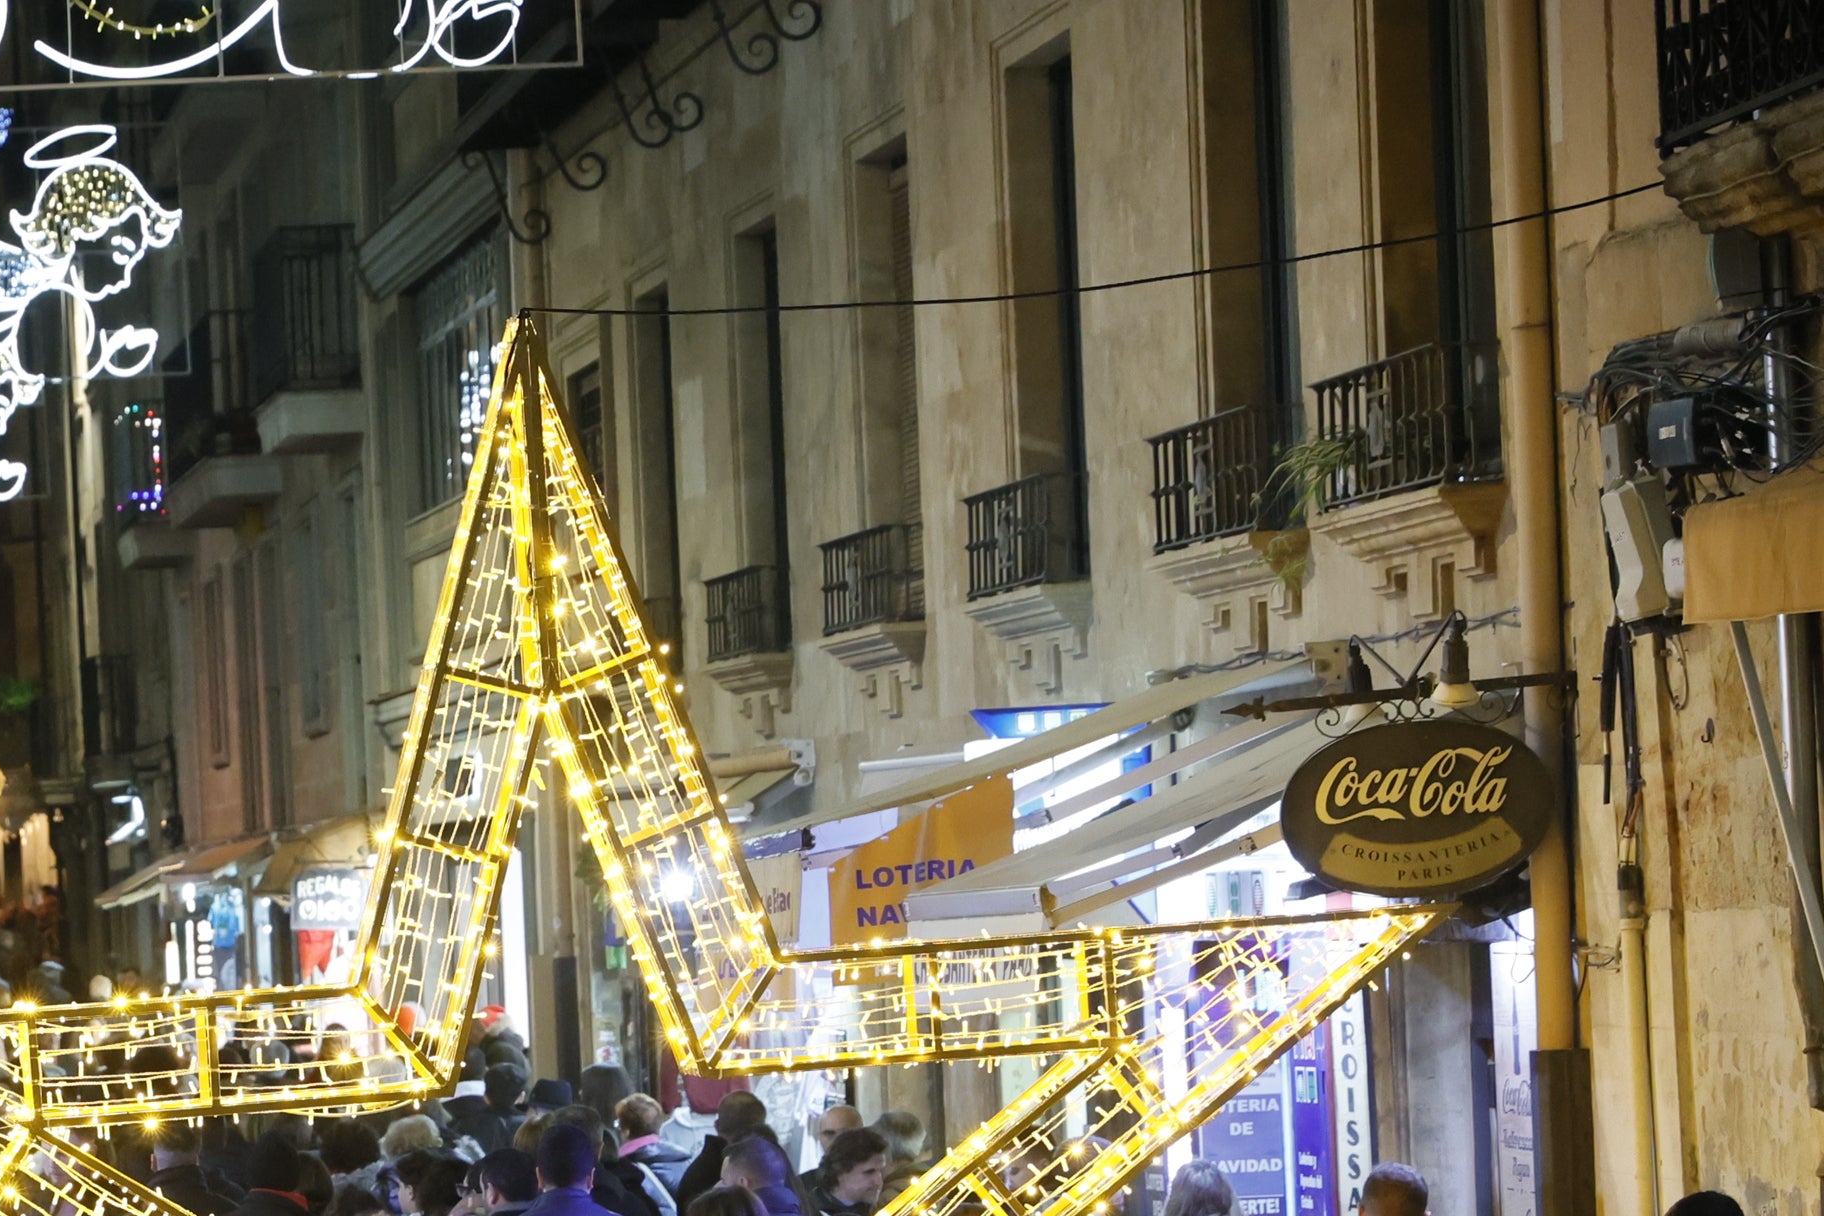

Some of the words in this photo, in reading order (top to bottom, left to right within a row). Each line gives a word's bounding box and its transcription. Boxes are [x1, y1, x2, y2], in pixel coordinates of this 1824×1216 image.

[1315, 745, 1513, 825] Coca-Cola
[1341, 831, 1500, 863] CROISSANTERIA
[856, 859, 976, 890] LOTERIA
[1397, 863, 1453, 881] PARIS
[1229, 1121, 1254, 1136] DE
[1213, 1158, 1283, 1174] AVIDAD
